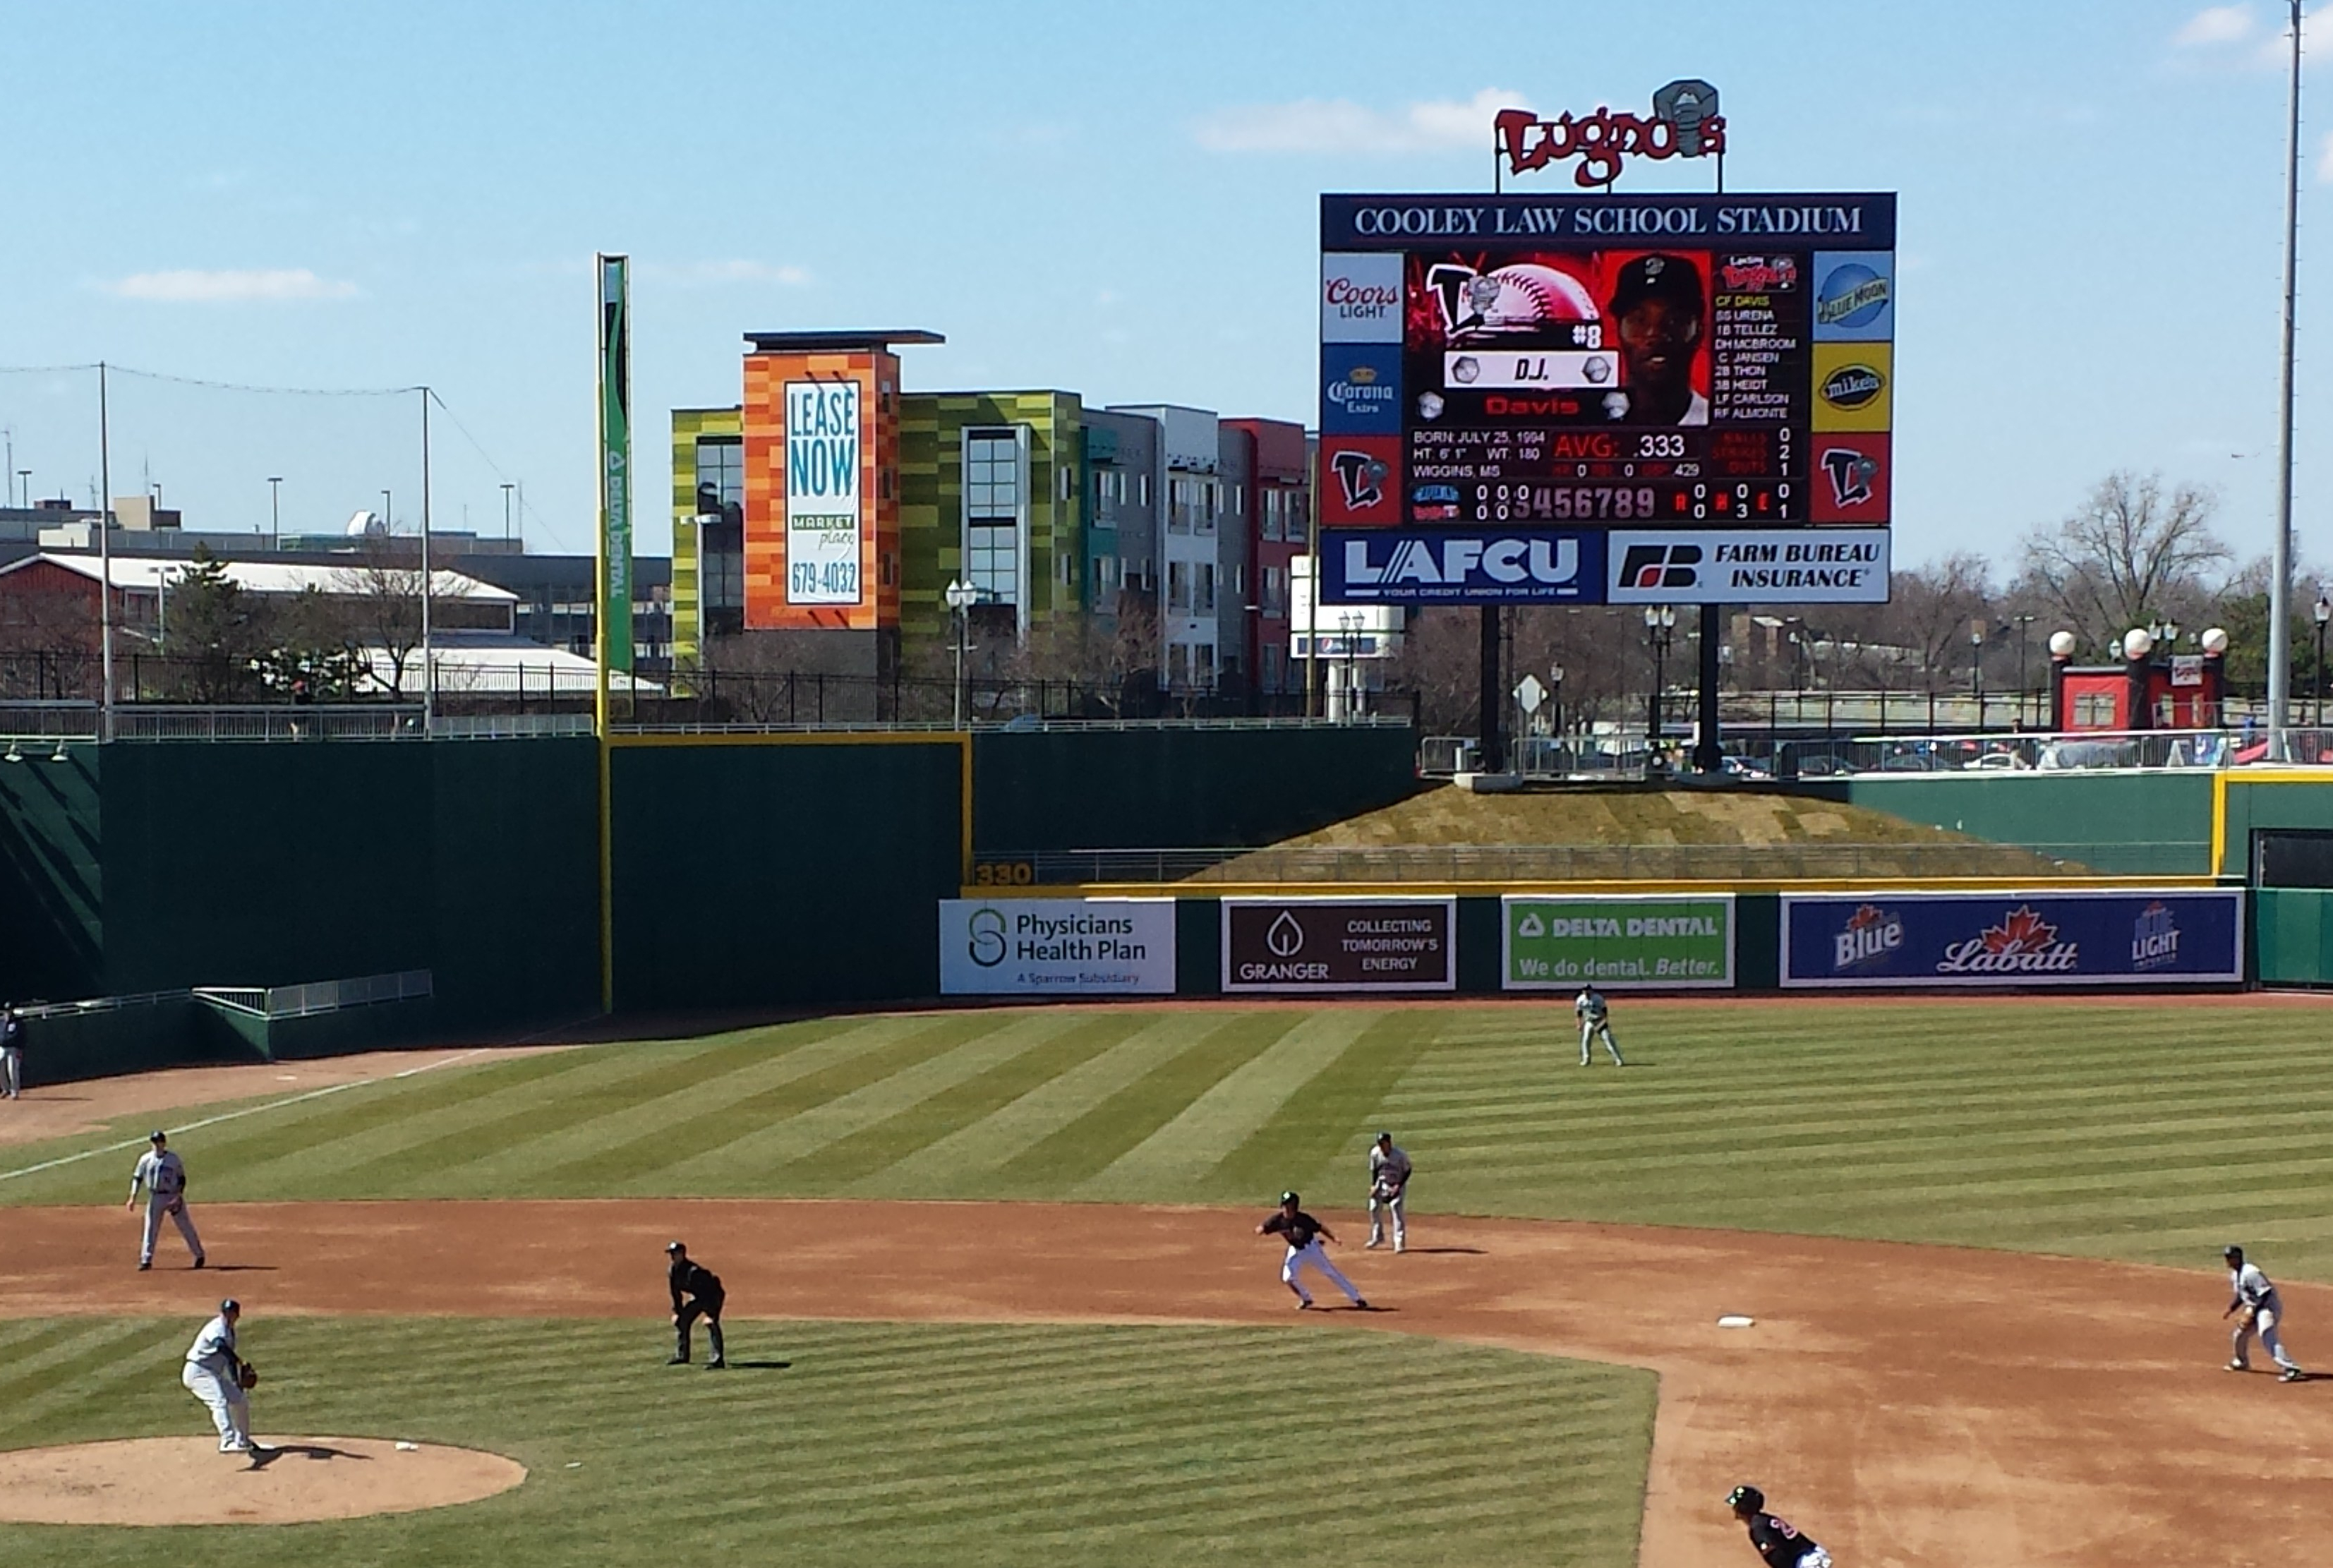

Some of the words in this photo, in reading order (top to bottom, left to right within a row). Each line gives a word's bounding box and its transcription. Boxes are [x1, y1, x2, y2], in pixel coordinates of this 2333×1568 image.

[1354, 207, 1485, 234] COOLEY
[1494, 207, 1565, 234] LAW
[1574, 207, 1708, 234] SCHOOL
[1717, 206, 1862, 234] STADIUM
[1327, 277, 1399, 305] Coors
[1716, 295, 1731, 307] CF
[1735, 295, 1770, 307] DAVIS
[1340, 305, 1386, 319] LIGHT
[1734, 309, 1775, 321] URENA
[1572, 325, 1602, 349] #8
[1717, 324, 1731, 335] 1B
[1733, 324, 1778, 335] TELLEZ
[1715, 338, 1732, 350] DH
[1734, 338, 1797, 350] MCBROOM
[1718, 352, 1728, 363] C
[1733, 352, 1780, 363] JANSEN
[1514, 358, 1550, 381] D.J.
[1714, 366, 1729, 377] 2B
[1733, 366, 1766, 376] THON
[1327, 382, 1393, 404] Corona
[1714, 380, 1729, 391] 3B
[1732, 380, 1768, 391] HEIDT
[1485, 396, 1580, 416] Davis
[1715, 393, 1730, 404] LF
[1732, 393, 1790, 404] CARLSON
[790, 391, 855, 436] LEASE
[1714, 407, 1729, 418] RF
[1732, 407, 1788, 418] ALMONTE
[1413, 430, 1453, 444] BORN:
[1457, 430, 1490, 444] JULY
[1517, 430, 1545, 444] 1994
[1779, 427, 1791, 442] 0
[1519, 447, 1540, 459] 180
[1554, 433, 1620, 458] AVG:
[1633, 434, 1685, 458] .333
[1779, 444, 1791, 459] 2
[790, 438, 856, 497] NOW
[1413, 464, 1476, 479] WIGGINS,
[1480, 464, 1501, 478] MS
[1577, 463, 1587, 478] 0
[1624, 463, 1634, 478] 0
[1780, 462, 1788, 477] 1
[1476, 484, 1488, 500] 0
[1497, 484, 1509, 500] 0
[1517, 484, 1530, 500] 0
[1694, 483, 1706, 499] 0
[1736, 483, 1749, 499] 0
[1778, 483, 1790, 499] 0
[609, 476, 624, 529] DELTA
[1476, 504, 1488, 520] 0
[1496, 504, 1509, 520] 0
[1694, 503, 1706, 520] 0
[1736, 503, 1749, 519] 3
[1779, 503, 1788, 519] 1
[793, 516, 852, 529] MARKET
[818, 527, 855, 550] place
[1344, 538, 1579, 584] LAFCU
[1715, 543, 1779, 562] FARM
[1785, 543, 1880, 562] BUREAU
[610, 531, 625, 598] DENTAL
[792, 562, 857, 593] 679-4032
[1384, 587, 1417, 597] YOUR
[1419, 587, 1461, 597] CREDIT
[1464, 587, 1503, 597] UNION
[1505, 587, 1529, 597] FOR
[1531, 587, 1556, 597] LIFE
[976, 862, 1032, 886] 330
[1017, 913, 1133, 941] Physicians
[1346, 919, 1433, 934] COLLECTING
[1553, 917, 1622, 937] DELTA
[1626, 917, 1718, 937] DENTAL
[1017, 939, 1092, 960] Health
[1097, 939, 1146, 960] Plan
[1342, 938, 1438, 953] TOMORROW'S
[1835, 923, 1901, 967] Blue
[2132, 929, 2181, 960] LIGHT
[1936, 938, 2078, 972] Labatt
[1240, 963, 1329, 980] GRANGER
[1361, 957, 1418, 972] ENERGY
[1519, 958, 1549, 977] We
[1554, 958, 1579, 977] do
[1583, 958, 1651, 977] dental.
[1655, 958, 1720, 977] Better.
[1017, 973, 1027, 984] A
[1028, 972, 1077, 986] Sparrow
